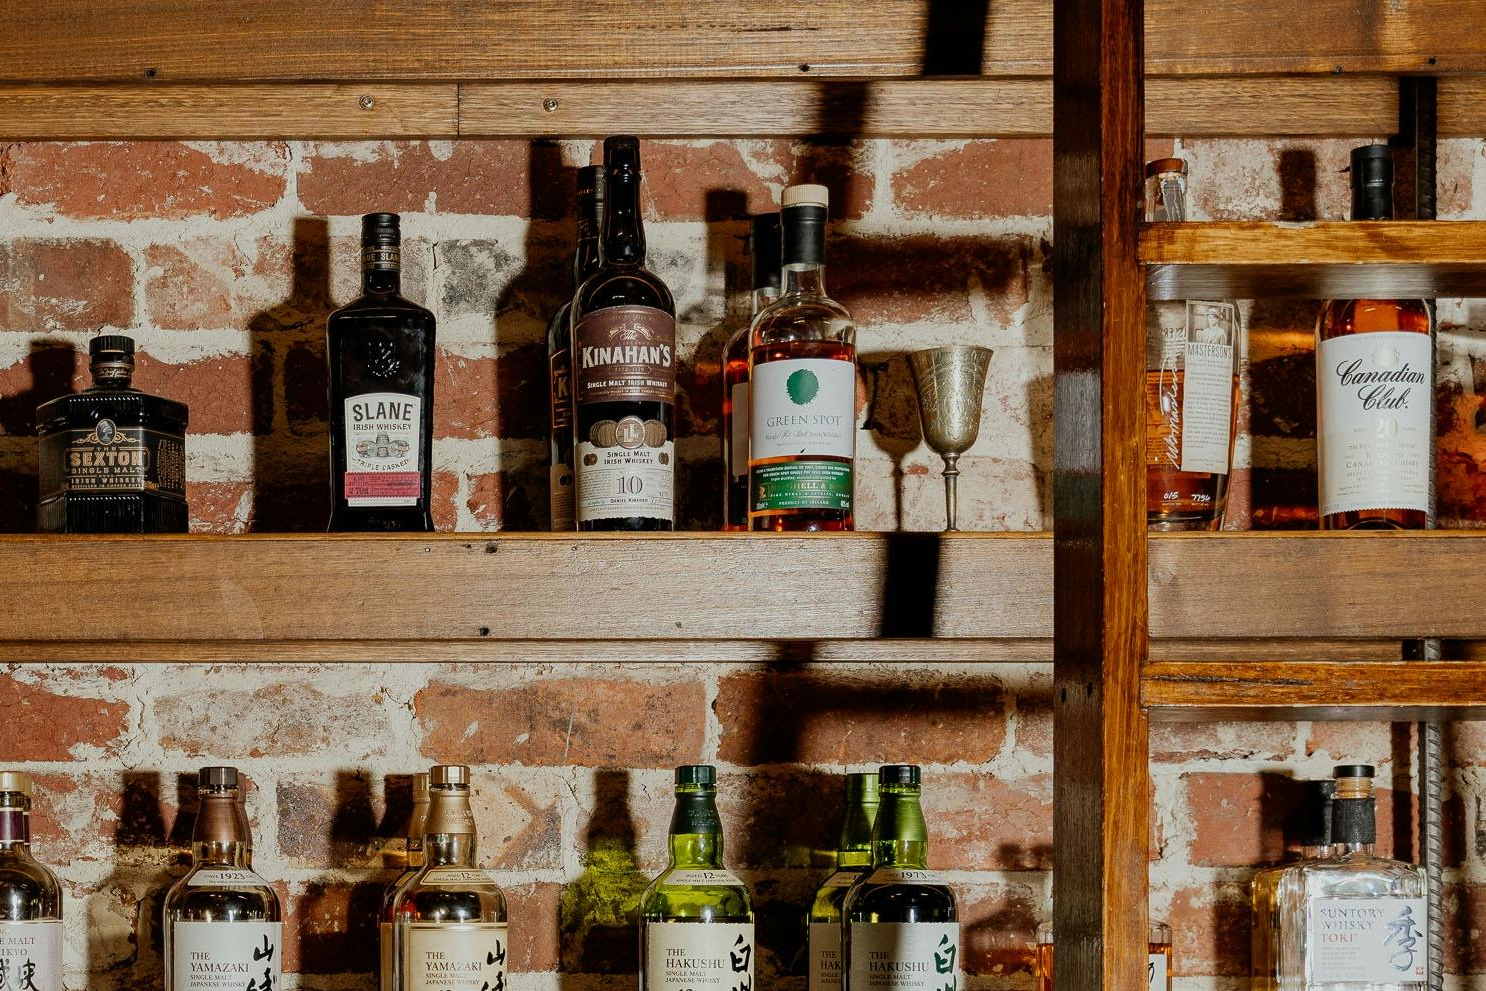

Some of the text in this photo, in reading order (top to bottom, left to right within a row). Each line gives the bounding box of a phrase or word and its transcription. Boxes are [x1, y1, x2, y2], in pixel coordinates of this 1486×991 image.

[582, 343, 671, 369] KINAHAN'S
[1335, 360, 1426, 388] Canadian
[587, 381, 607, 389] SINGLE
[647, 380, 668, 388] WHISKEY
[352, 402, 413, 422] SLANE
[767, 415, 840, 428] GREEN SPOT
[377, 423, 412, 431] WHISKEY
[70, 452, 143, 467] SEXTON
[616, 475, 643, 494] 10
[1320, 908, 1384, 918] SUNTORY
[1322, 921, 1373, 930] WHISKY
[8, 937, 35, 945] MALT
[1322, 934, 1353, 942] TOKI
[190, 952, 210, 960] THE
[426, 951, 445, 959] THE
[190, 963, 250, 972] YAMAZAKI
[426, 962, 482, 971] YAMAZAKI
[666, 959, 725, 969] HAKUSHU
[869, 962, 929, 971] HAKUSHU
